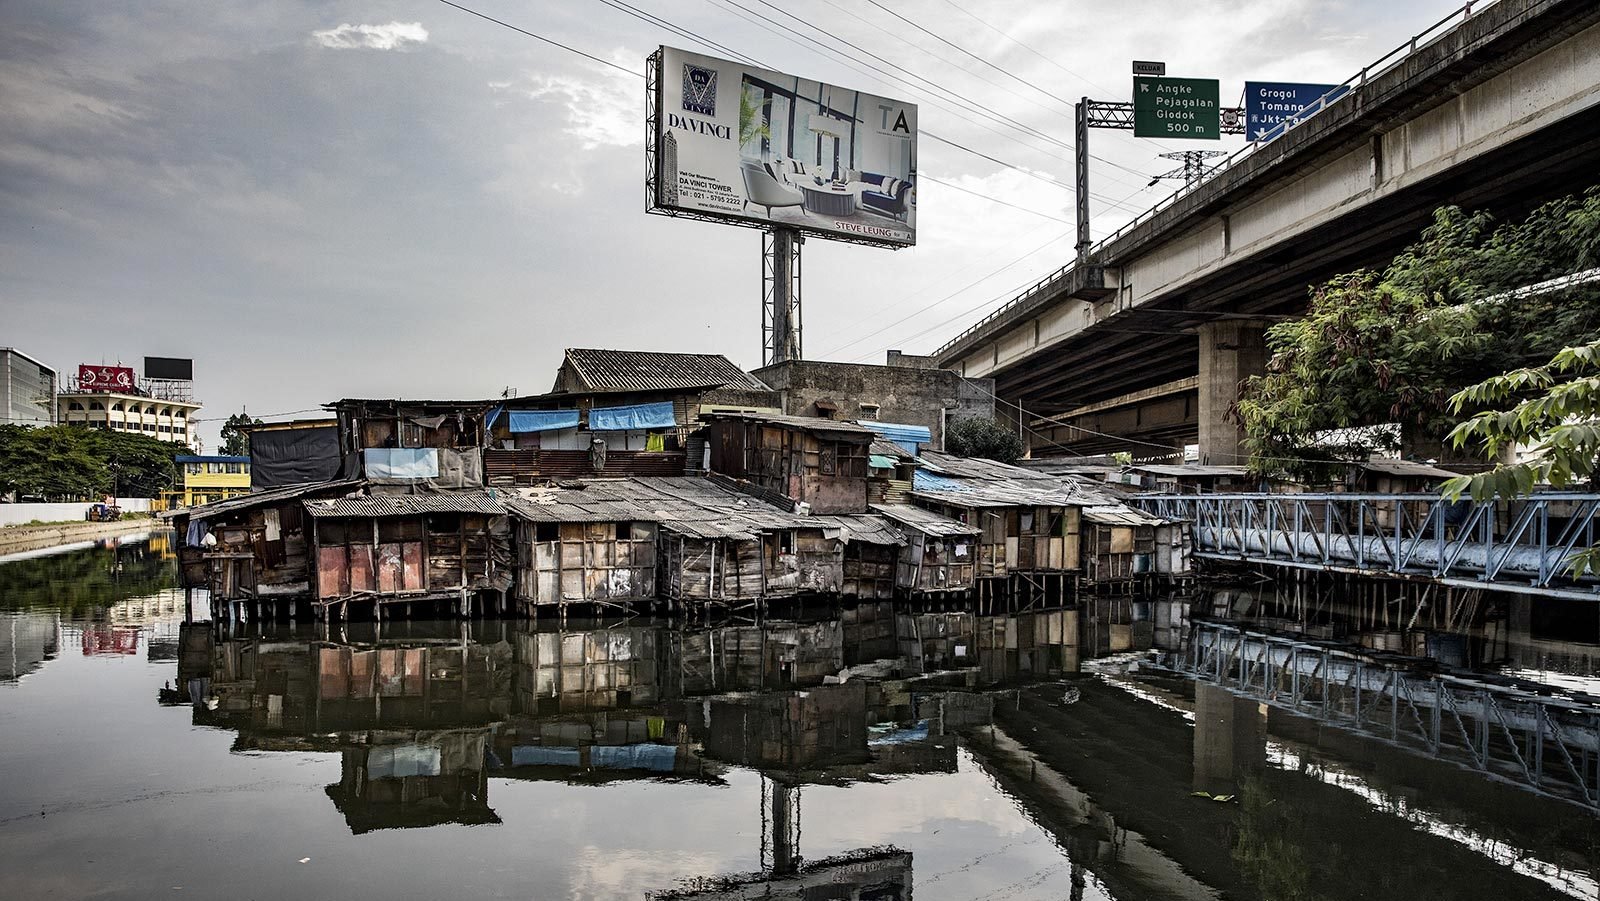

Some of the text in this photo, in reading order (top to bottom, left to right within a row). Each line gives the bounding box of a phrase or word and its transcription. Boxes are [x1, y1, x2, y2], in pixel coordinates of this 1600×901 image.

[1156, 84, 1192, 95] Angke
[1260, 88, 1296, 100] Grogol
[1156, 96, 1214, 108] Pejagalan
[1156, 109, 1195, 119] Glodok
[1167, 123, 1204, 133] 500 m
[679, 177, 732, 192] DA VINCI TOWER
[679, 189, 688, 197] Tel
[726, 197, 741, 205] 2222
[835, 221, 861, 233] STEVE
[863, 226, 892, 237] LEUNG
